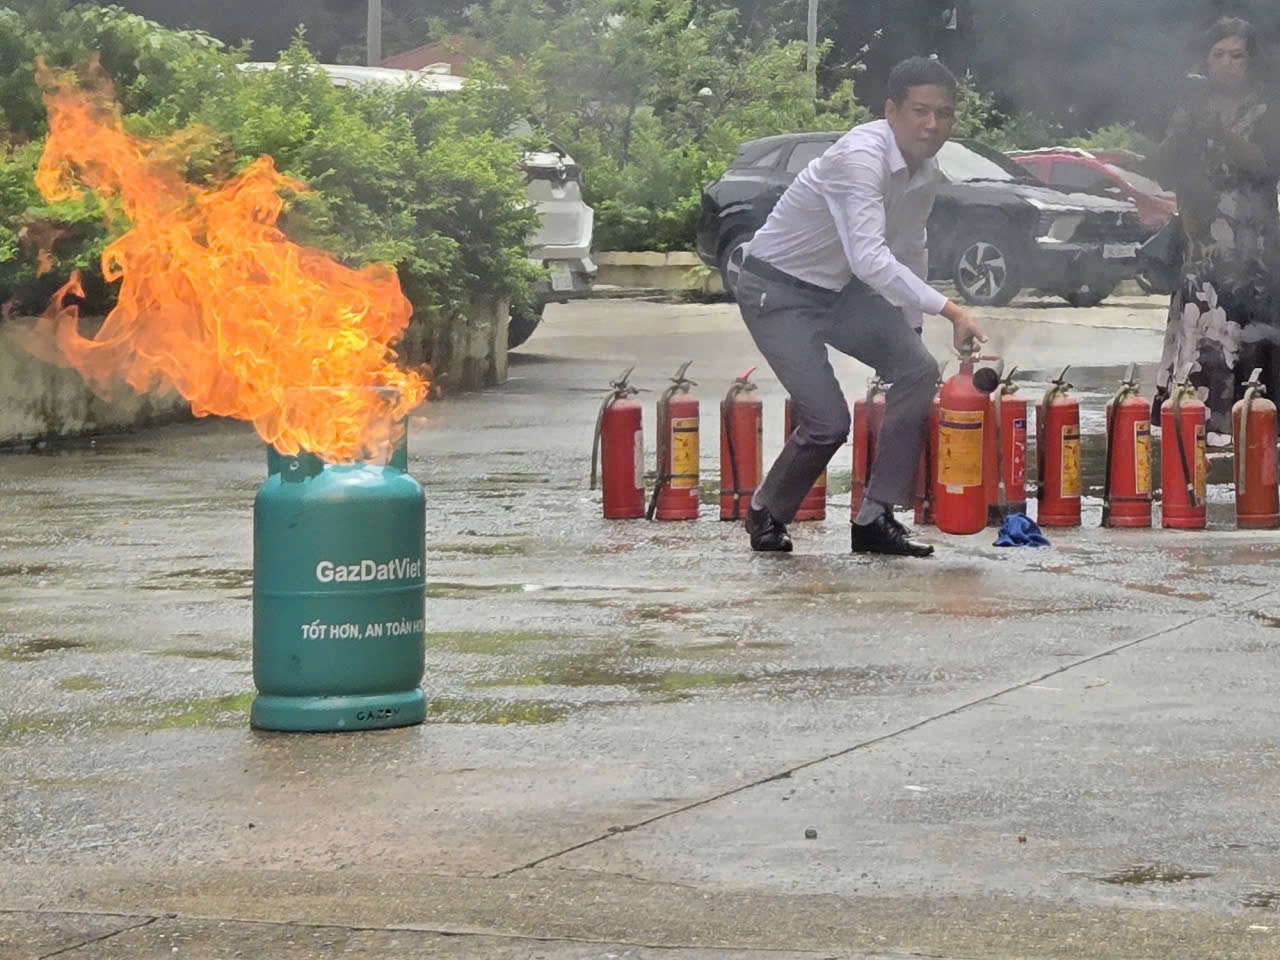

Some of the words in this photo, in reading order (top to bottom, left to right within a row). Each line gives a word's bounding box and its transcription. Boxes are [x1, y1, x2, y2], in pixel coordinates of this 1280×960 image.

[316, 558, 421, 583] GazDatViet
[301, 619, 327, 639] TỐT
[330, 623, 362, 640] HƠN,
[364, 623, 383, 637] AN
